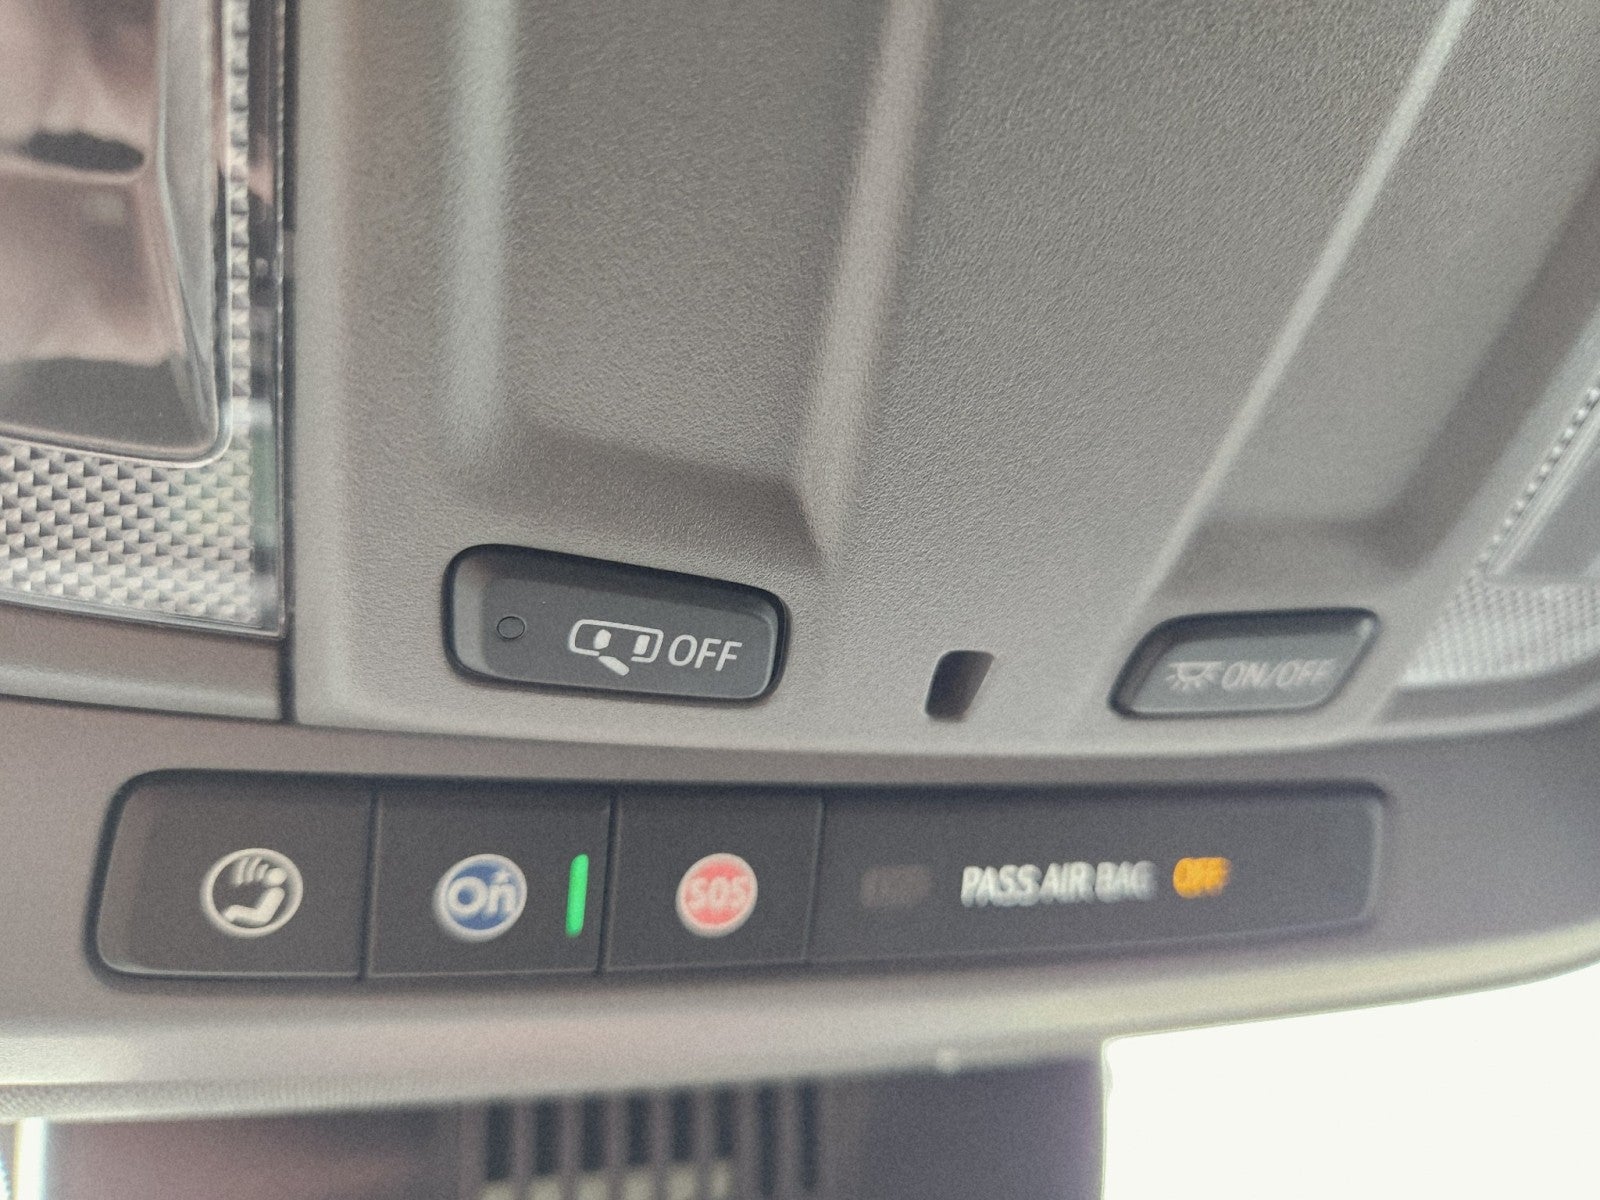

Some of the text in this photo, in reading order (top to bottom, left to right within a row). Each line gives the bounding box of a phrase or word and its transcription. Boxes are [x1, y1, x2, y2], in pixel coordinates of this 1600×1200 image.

[667, 634, 743, 671] OFF
[1221, 658, 1335, 691] ON/OFF
[683, 874, 753, 911] SOS
[961, 864, 1042, 906] PASS
[1040, 861, 1096, 904] AIR
[1095, 860, 1157, 902] BAG
[1173, 856, 1231, 898] OFF
